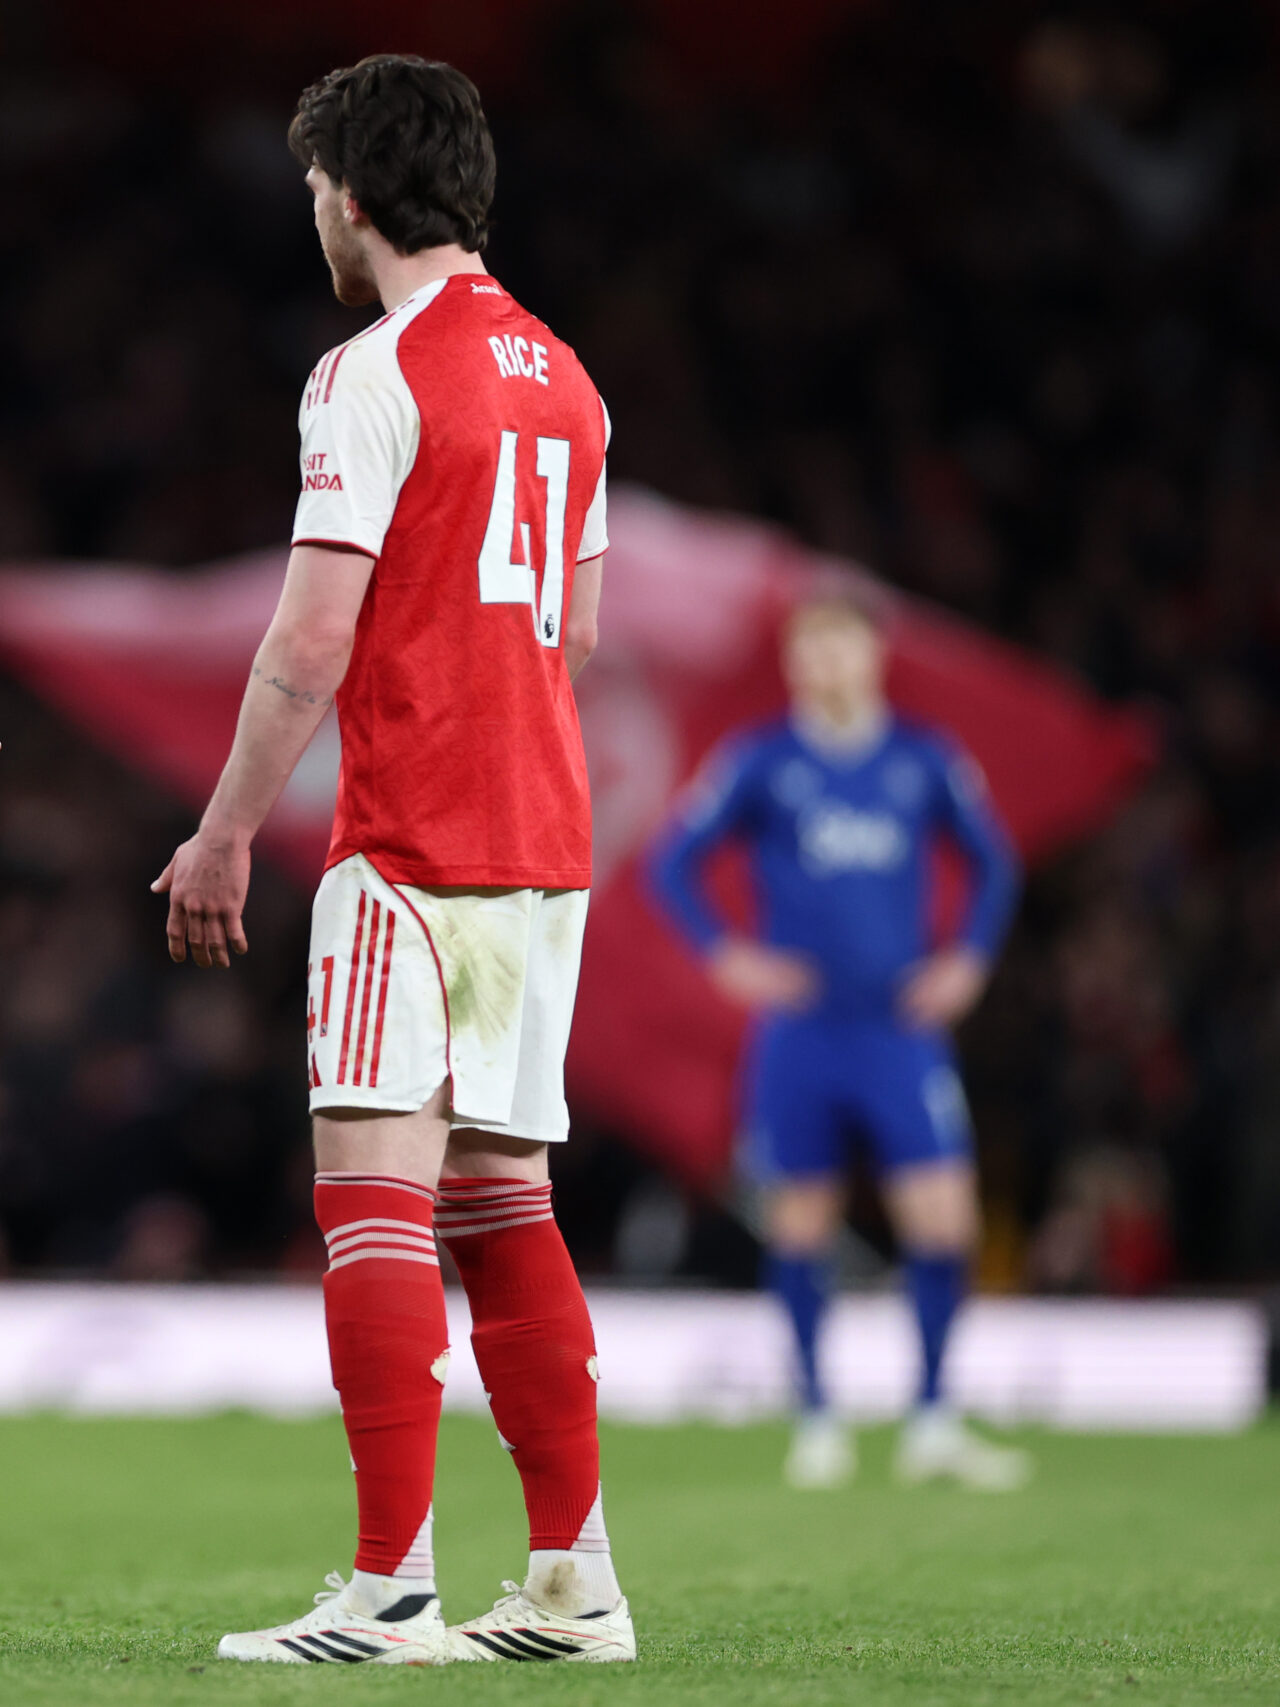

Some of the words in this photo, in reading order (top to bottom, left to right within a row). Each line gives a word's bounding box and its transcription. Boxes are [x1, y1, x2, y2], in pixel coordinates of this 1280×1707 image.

[488, 334, 549, 386] RICE
[303, 453, 327, 470] SIT
[478, 429, 570, 648] 41
